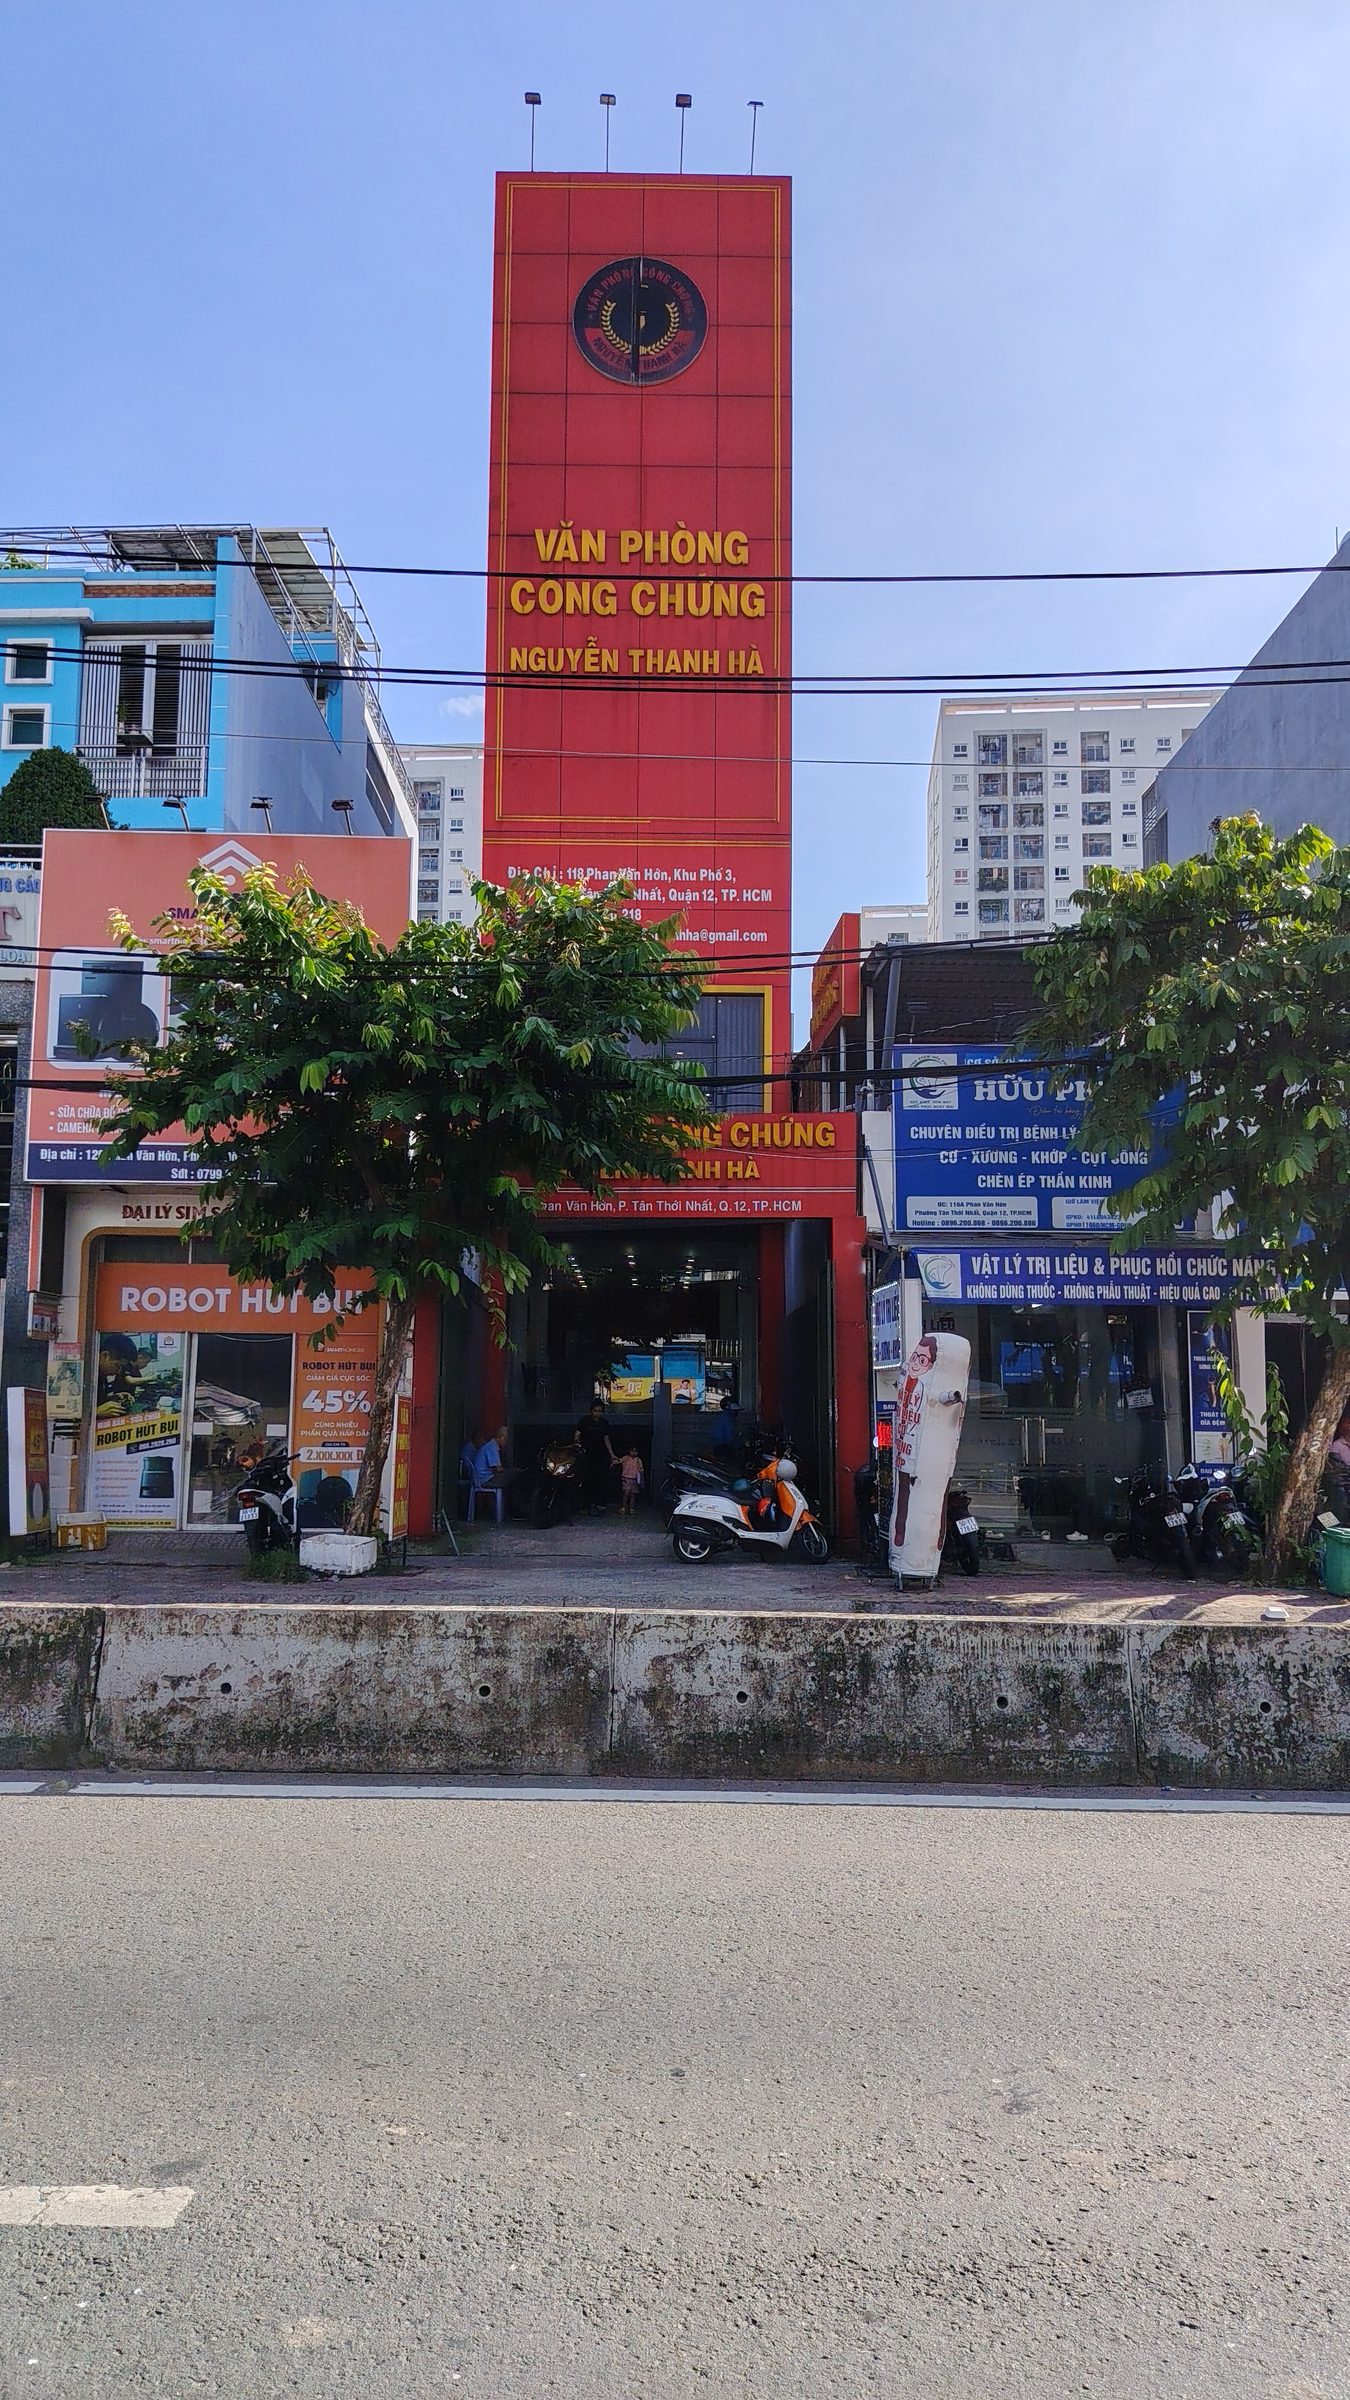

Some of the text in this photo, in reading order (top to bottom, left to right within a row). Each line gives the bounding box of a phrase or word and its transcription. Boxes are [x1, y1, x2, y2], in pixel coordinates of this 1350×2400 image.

[534, 520, 749, 564] VĂN PHÒNG
[631, 574, 766, 617] CHỨNG
[510, 636, 764, 674] NGUYỄN THANH HÀ
[566, 868, 584, 881] 118
[586, 868, 616, 881] Phan
[644, 867, 671, 883] Hớn,
[673, 868, 697, 882] Khu
[699, 867, 723, 882] Phố
[725, 869, 736, 884] 3,
[668, 889, 700, 905] Quận
[701, 890, 718, 904] 12,
[721, 891, 740, 902] TP.
[742, 889, 773, 902] HCM
[973, 1074, 1045, 1101] HỮU
[729, 1116, 837, 1148] CHỨNG
[910, 1124, 963, 1140] CHUYÊN
[965, 1122, 996, 1140] ĐIỀU
[999, 1126, 1020, 1142] TRỊ
[1023, 1124, 1058, 1142] BỆNH
[40, 1148, 57, 1163] Địa
[136, 1149, 155, 1162] Văn
[157, 1148, 181, 1164] Hớn,
[1031, 1147, 1066, 1164] KHỚP
[727, 1155, 761, 1180] HÀ
[977, 1170, 1113, 1189] CHÈN ÉP THẦN KINH
[122, 1204, 150, 1222] ĐẠI
[154, 1202, 173, 1220] LÝ
[175, 1205, 207, 1220] SIM
[565, 1200, 588, 1212] Văn
[589, 1199, 616, 1213] Hớn,
[618, 1200, 629, 1212] P.
[631, 1200, 653, 1212] Tân
[656, 1199, 683, 1212] Thới
[685, 1198, 717, 1214] Nhất,
[912, 1219, 936, 1227] Hotline
[971, 1252, 1000, 1279] VẬT
[1004, 1252, 1023, 1275] LÝ
[1026, 1256, 1051, 1279] TRỊ
[1055, 1253, 1089, 1279] LIỆU
[1093, 1257, 1105, 1276] &
[1109, 1256, 1152, 1280] PHỤC
[1155, 1251, 1182, 1276] HỒI
[1187, 1254, 1228, 1277] CHỨC
[121, 1286, 232, 1313] ROBOT
[966, 1282, 998, 1299] KHÔNG
[1000, 1282, 1025, 1299] DÙNG
[1026, 1280, 1056, 1299] THUỐC
[1063, 1282, 1095, 1299] KHÔNG
[1097, 1280, 1121, 1299] PHẪU
[1123, 1283, 1151, 1302] THUẬT
[1159, 1283, 1180, 1302] HIỆU
[1182, 1282, 1201, 1301] QUẢ
[1202, 1285, 1221, 1301] CAO
[302, 1361, 335, 1371] ROBOT
[337, 1359, 358, 1371] HÚT
[326, 1373, 339, 1382] GIÁ
[302, 1389, 373, 1413] 45%
[1199, 1410, 1219, 1418] THOÁT
[96, 1419, 179, 1447] ROBOT HÚT BỤI
